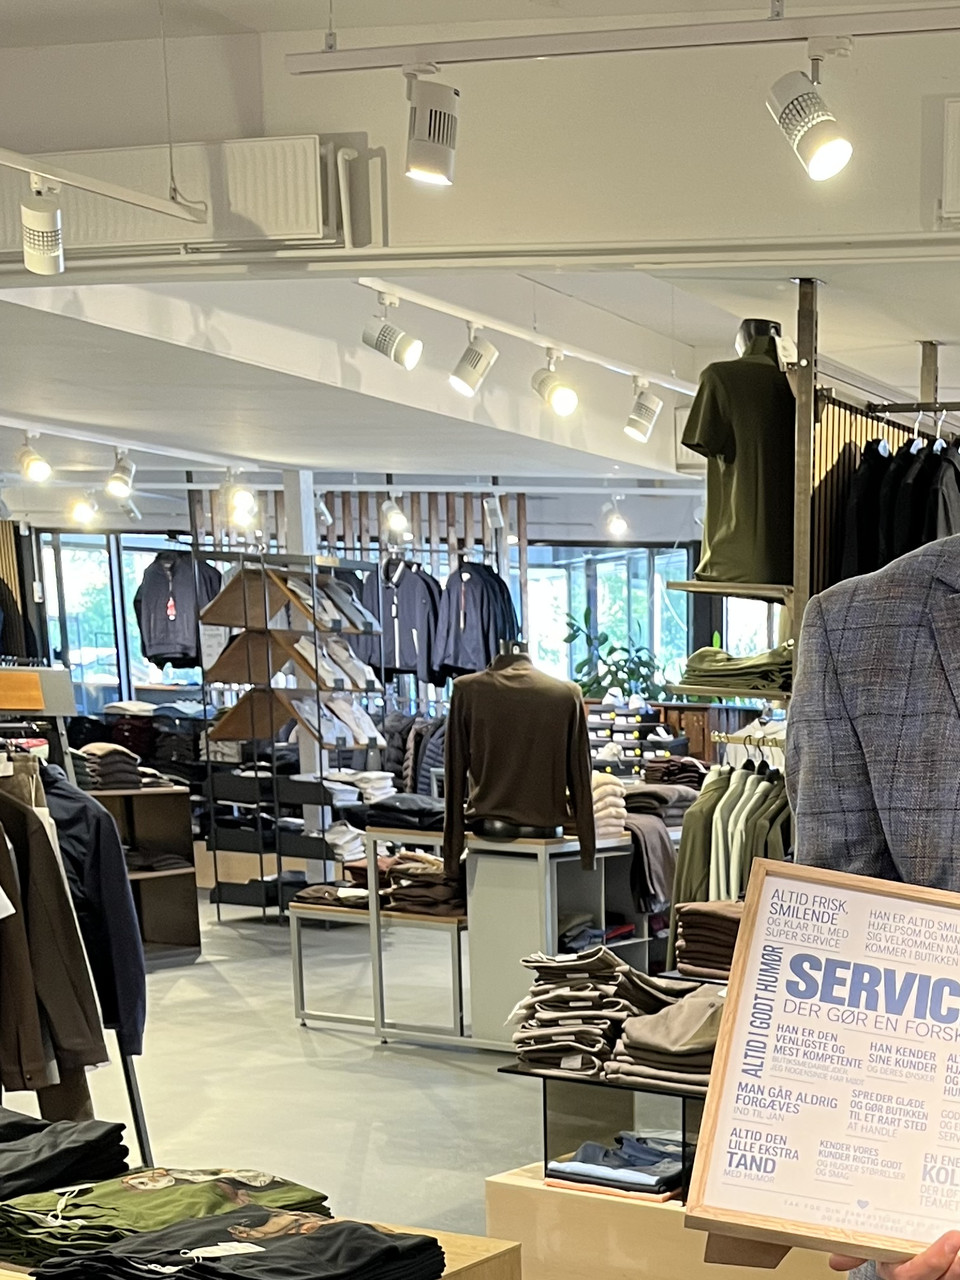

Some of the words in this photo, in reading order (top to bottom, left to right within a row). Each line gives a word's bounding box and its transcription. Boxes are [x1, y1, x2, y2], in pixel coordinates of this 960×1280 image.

[771, 888, 809, 906] ALTID
[812, 895, 849, 915] FRISK,
[769, 902, 839, 926] SMILENDE
[869, 909, 891, 922] HAN
[893, 913, 905, 924] ER
[907, 916, 935, 930] ALTID
[765, 926, 798, 941] SUPER
[800, 932, 840, 948] SERVICE
[767, 916, 780, 927] OG
[784, 920, 809, 932] KLAR
[812, 924, 824, 935] TIL
[827, 927, 849, 938] MED
[867, 921, 922, 938] HJÆLPSOM
[924, 929, 938, 941] OG
[940, 933, 960, 945] MAN
[866, 931, 882, 943] SIG
[884, 934, 945, 953] VELKOMMEN
[864, 942, 907, 959] KOMMER
[914, 951, 959, 967] BUTIKKEN
[755, 944, 784, 993] HUMØR
[749, 993, 775, 1030] GODT
[783, 998, 821, 1019] DER
[827, 1006, 868, 1027] GØR
[874, 1014, 899, 1032] EN
[776, 1023, 799, 1036] HAN
[801, 1027, 815, 1039] ER
[817, 1030, 838, 1042] DEN
[775, 1033, 830, 1052] VENLIGSTE
[831, 1044, 845, 1055] OG
[869, 1041, 893, 1054] HAN
[895, 1046, 936, 1062] KENDER
[741, 1039, 767, 1079] ALTID
[773, 1044, 801, 1058] MEST
[802, 1049, 863, 1069] KOMPETENTE
[868, 1053, 892, 1066] SINE
[894, 1057, 937, 1074] KUNDER
[866, 1064, 878, 1074] OG
[880, 1066, 906, 1079] DERES
[944, 1075, 959, 1086] OG
[735, 1093, 800, 1115] FORGÆVES
[737, 1081, 765, 1096] MAN
[768, 1085, 792, 1101] GÅR
[795, 1091, 838, 1109] ALDRIG
[851, 1089, 894, 1104] SPREDER
[895, 1096, 926, 1110] GLÆDE
[733, 1106, 750, 1116] IND
[751, 1108, 764, 1119] TIL
[766, 1112, 785, 1122] JAN
[849, 1110, 862, 1122] TIL
[864, 1113, 876, 1123] ET
[877, 1115, 902, 1128] RART
[903, 1119, 927, 1132] STED
[850, 1099, 863, 1110] OG
[865, 1101, 884, 1114] GØR
[885, 1105, 929, 1121] BUTIKKEN
[730, 1127, 762, 1142] ALTID
[765, 1132, 787, 1146] DEN
[847, 1122, 858, 1131] AT
[860, 1124, 898, 1138] HANDLE
[940, 1121, 952, 1130] OG
[728, 1138, 757, 1153] LILLE
[758, 1143, 799, 1161] EKSTRA
[820, 1139, 851, 1152] KENDER
[853, 1145, 880, 1157] VORES
[924, 1153, 938, 1164] EN
[726, 1150, 777, 1174] TAND
[816, 1159, 828, 1168] OG
[829, 1161, 859, 1173] HUSKER
[818, 1149, 851, 1162] KUNDER
[852, 1154, 879, 1167] RIGTIG
[880, 1159, 903, 1171] GODT
[723, 1168, 742, 1178] MED
[815, 1168, 827, 1176] OG
[828, 1169, 849, 1180] SMAG
[920, 1184, 939, 1196] DER
[919, 1195, 960, 1212] TEAMET
